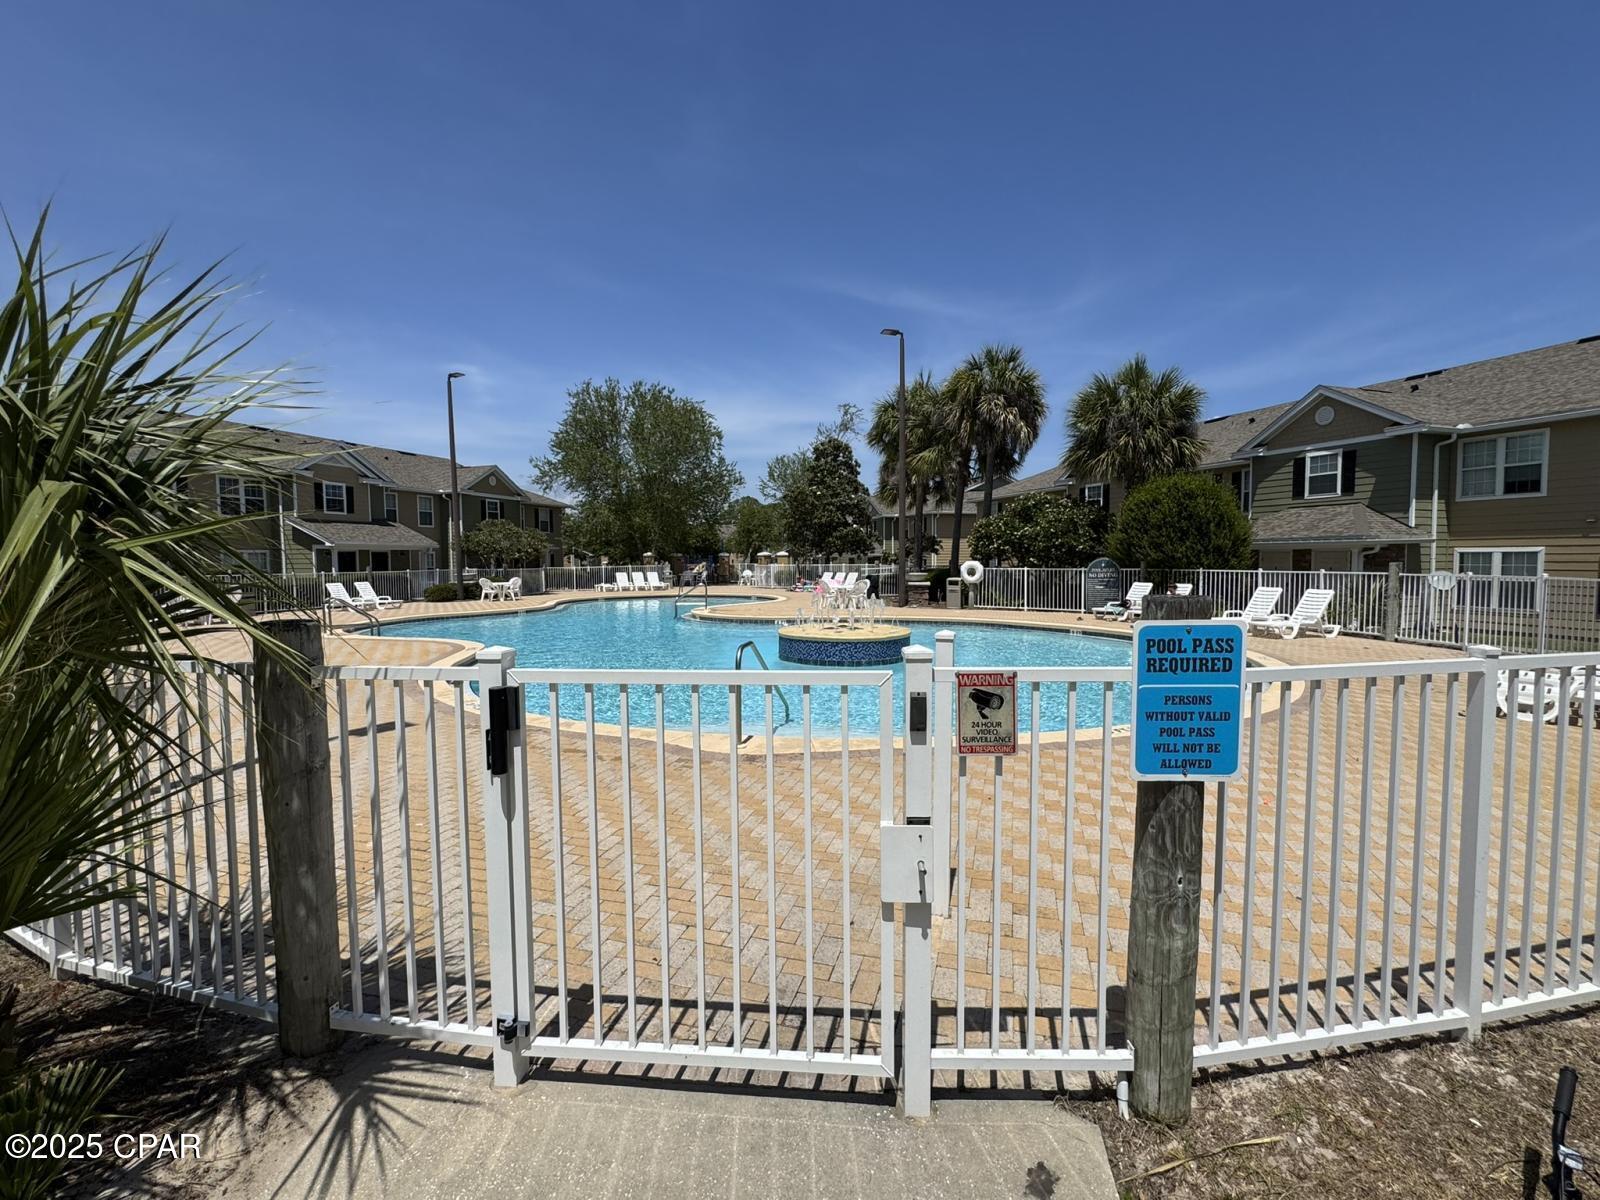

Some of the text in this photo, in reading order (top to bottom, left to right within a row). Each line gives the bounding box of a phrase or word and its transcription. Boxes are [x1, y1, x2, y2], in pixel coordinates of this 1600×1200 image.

[1145, 638, 1235, 654] POOL PASS
[1145, 657, 1233, 675] REQUIRED
[958, 674, 1014, 686] WARNING
[1163, 695, 1213, 705] PERSONS
[1145, 711, 1231, 721] WITHOUT VALID
[1159, 727, 1215, 737] POOL PASS
[961, 735, 1012, 743] SURVEILLANCE
[960, 745, 1014, 753] NO TRESPASSING
[1152, 743, 1221, 753] WILL NOT BE
[1159, 759, 1212, 769] ALLOWED
